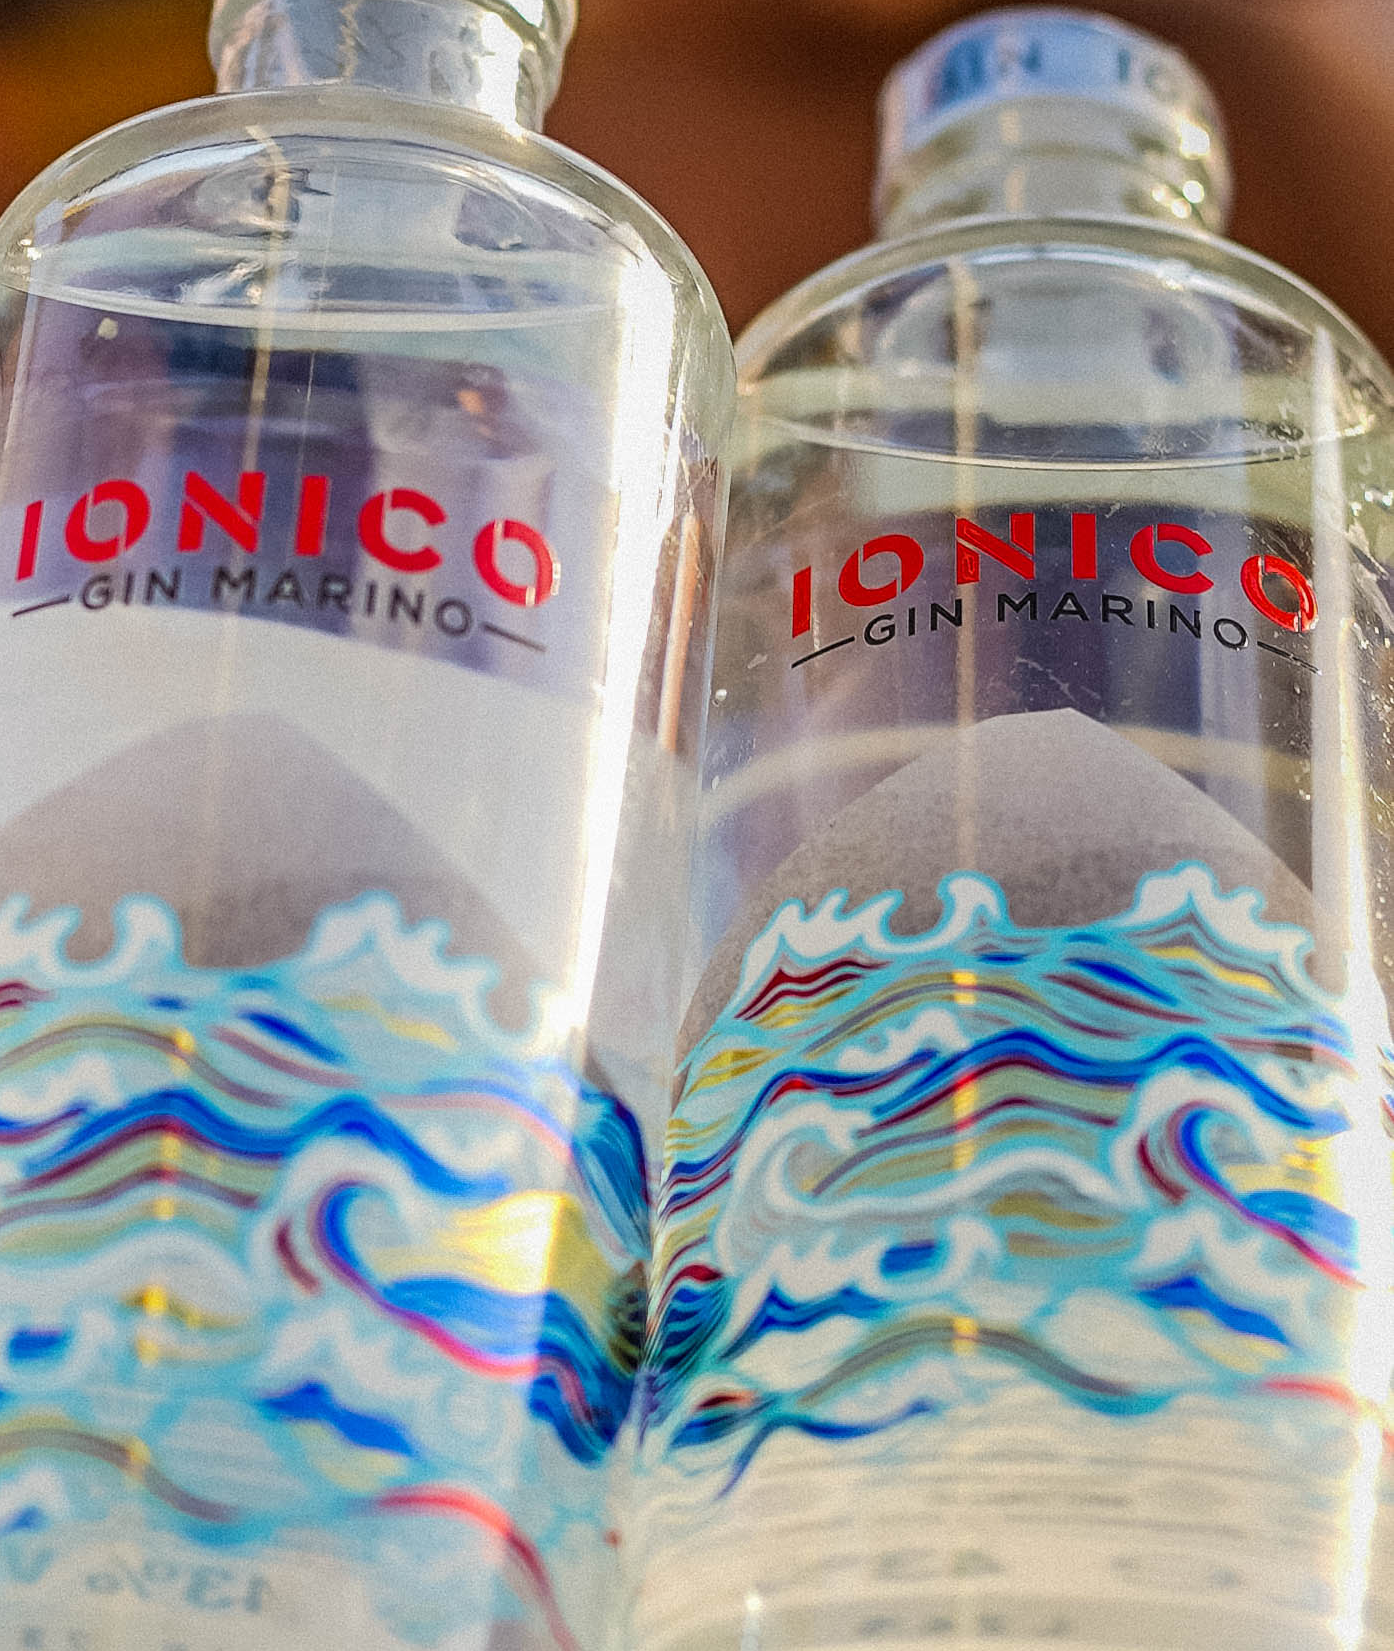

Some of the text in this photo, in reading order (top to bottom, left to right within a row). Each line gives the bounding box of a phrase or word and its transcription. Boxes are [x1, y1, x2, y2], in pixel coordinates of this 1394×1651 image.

[15, 470, 561, 608] IONICO
[791, 511, 1318, 634] IONICO
[79, 567, 475, 637] GIN MARINO
[863, 591, 1249, 651] GIN MARINO
